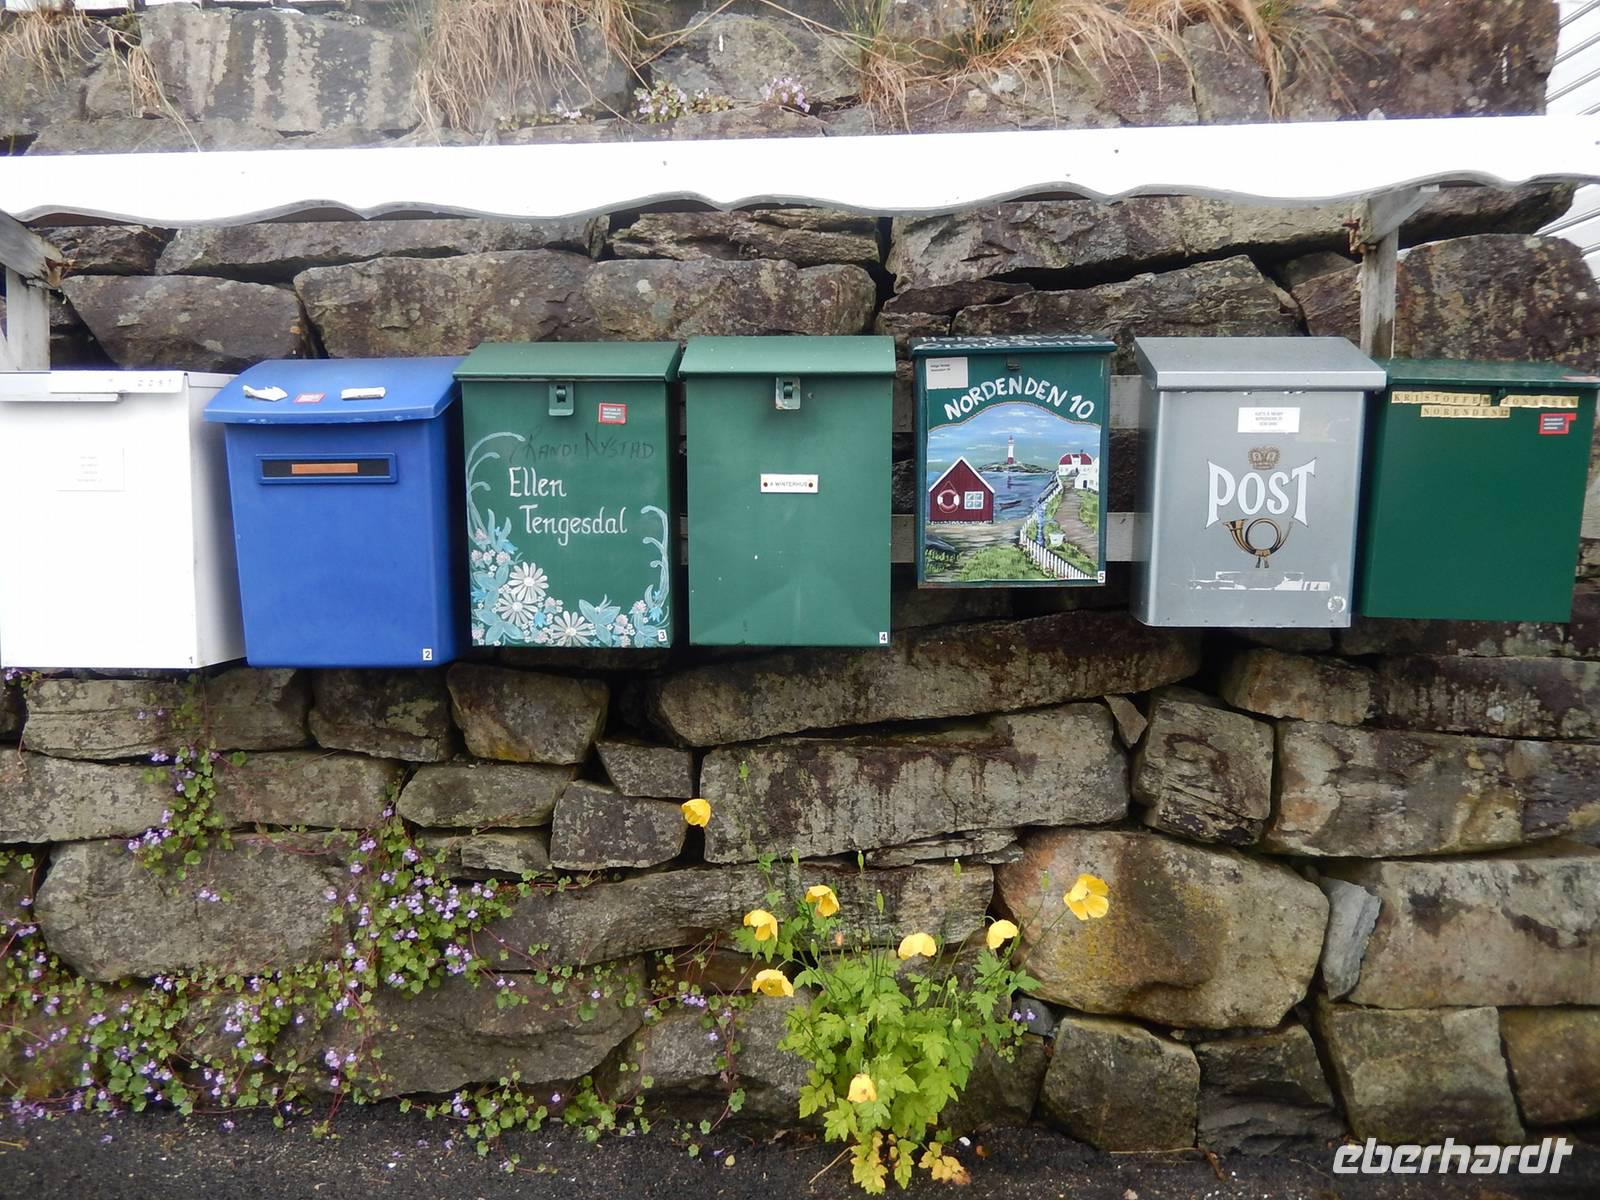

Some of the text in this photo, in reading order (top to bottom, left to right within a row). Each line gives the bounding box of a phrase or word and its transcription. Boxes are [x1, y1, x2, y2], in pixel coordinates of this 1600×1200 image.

[943, 375, 1096, 421] NORDENDEN 10
[508, 466, 568, 498] Ellen
[1205, 457, 1317, 529] POST
[518, 503, 629, 547] Tengesdal
